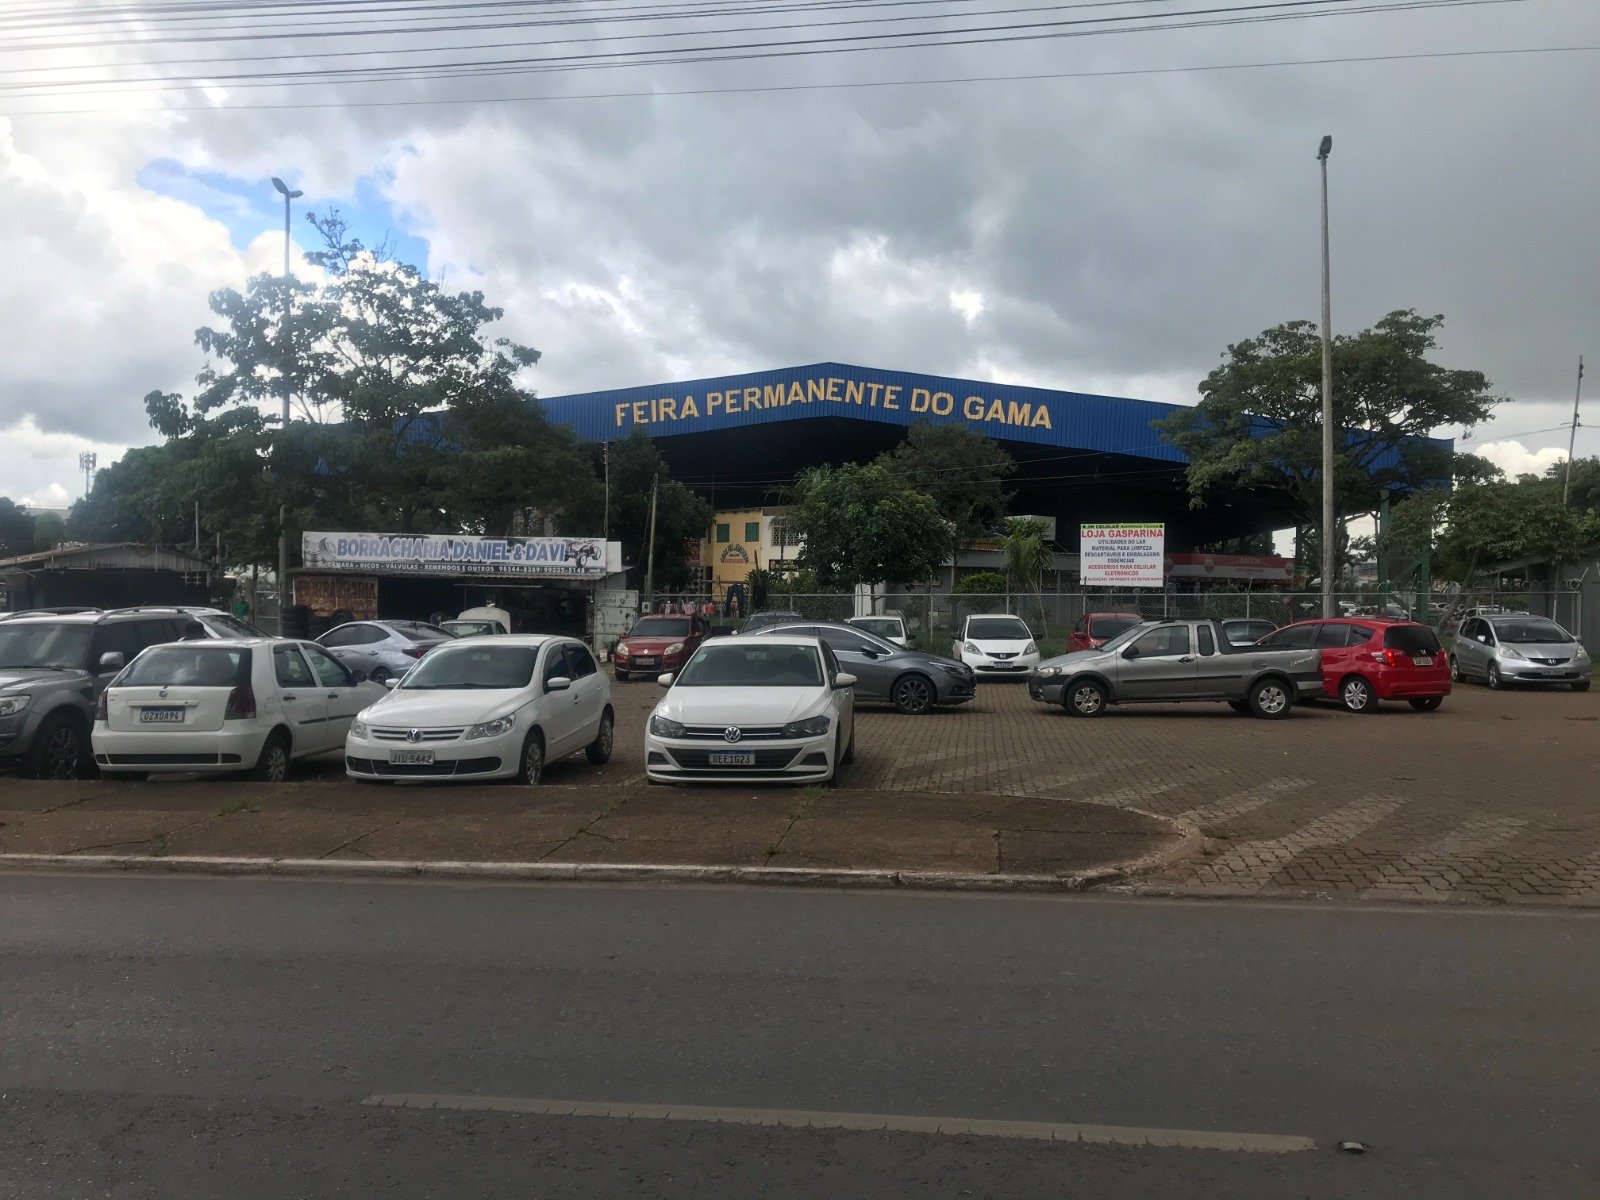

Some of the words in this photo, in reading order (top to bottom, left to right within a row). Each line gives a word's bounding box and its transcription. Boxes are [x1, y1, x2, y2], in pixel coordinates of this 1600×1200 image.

[615, 395, 699, 427] FEIRA
[706, 378, 902, 416] PERMANENTE
[910, 388, 954, 416] DO
[963, 396, 1052, 429] GAMA
[1082, 530, 1105, 538] LOJA
[1108, 530, 1163, 538] GASPARINA
[337, 537, 449, 559] BORRACHARIA
[452, 540, 509, 561] DANIEL
[513, 545, 523, 561] &
[525, 541, 566, 562] DAVI
[385, 561, 419, 570] VÁLVULAS
[712, 755, 751, 764] REE1G23
